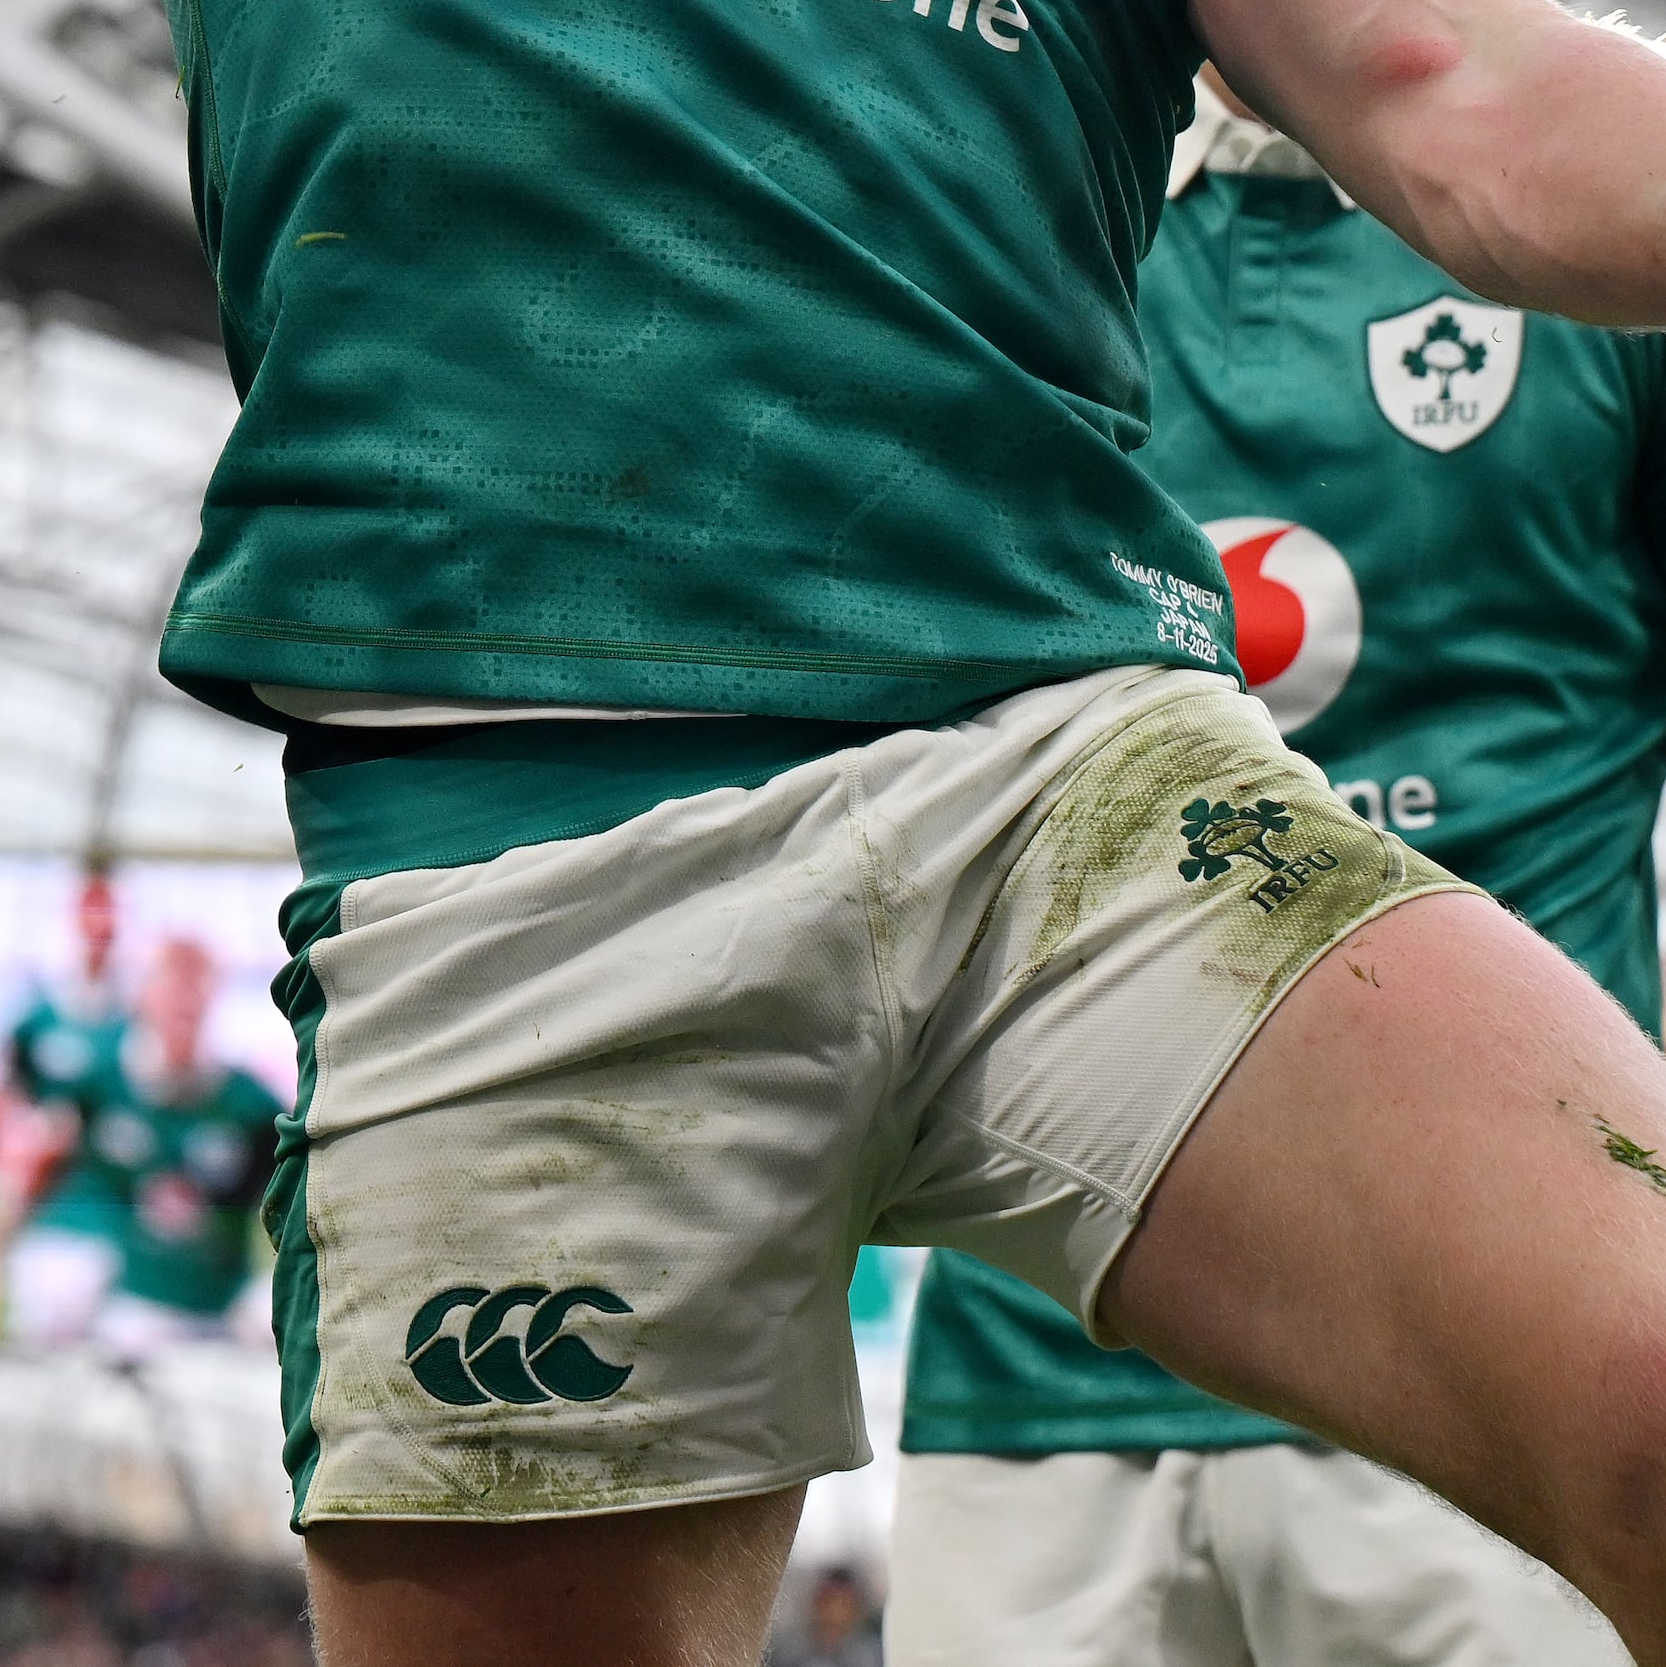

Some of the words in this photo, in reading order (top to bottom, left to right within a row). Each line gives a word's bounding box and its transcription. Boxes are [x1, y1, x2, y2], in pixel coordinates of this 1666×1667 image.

[1110, 551, 1162, 588] TOMMY
[1167, 574, 1223, 616] O'BRIEN
[1149, 587, 1181, 611] CAP
[1161, 607, 1212, 642] JAPAN
[1248, 847, 1340, 915] IRFU
